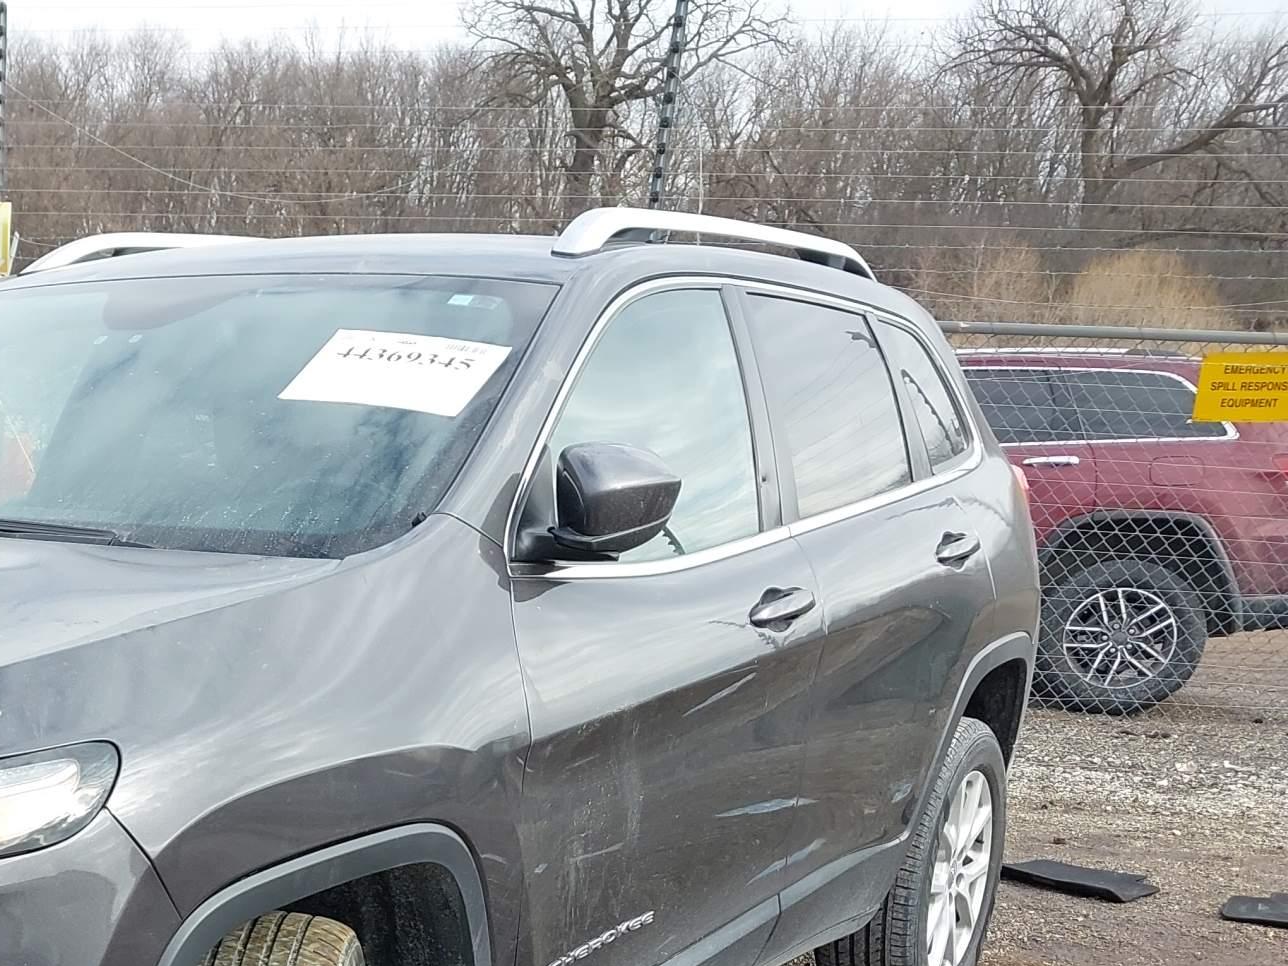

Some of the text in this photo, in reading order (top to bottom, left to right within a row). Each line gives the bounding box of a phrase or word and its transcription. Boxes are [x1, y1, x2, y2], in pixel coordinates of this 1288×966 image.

[337, 346, 476, 370] 44369345
[1224, 364, 1286, 375] EMERGENCY
[1210, 381, 1288, 391] SPILL RESPONS
[1220, 398, 1279, 408] EQUIPMENT
